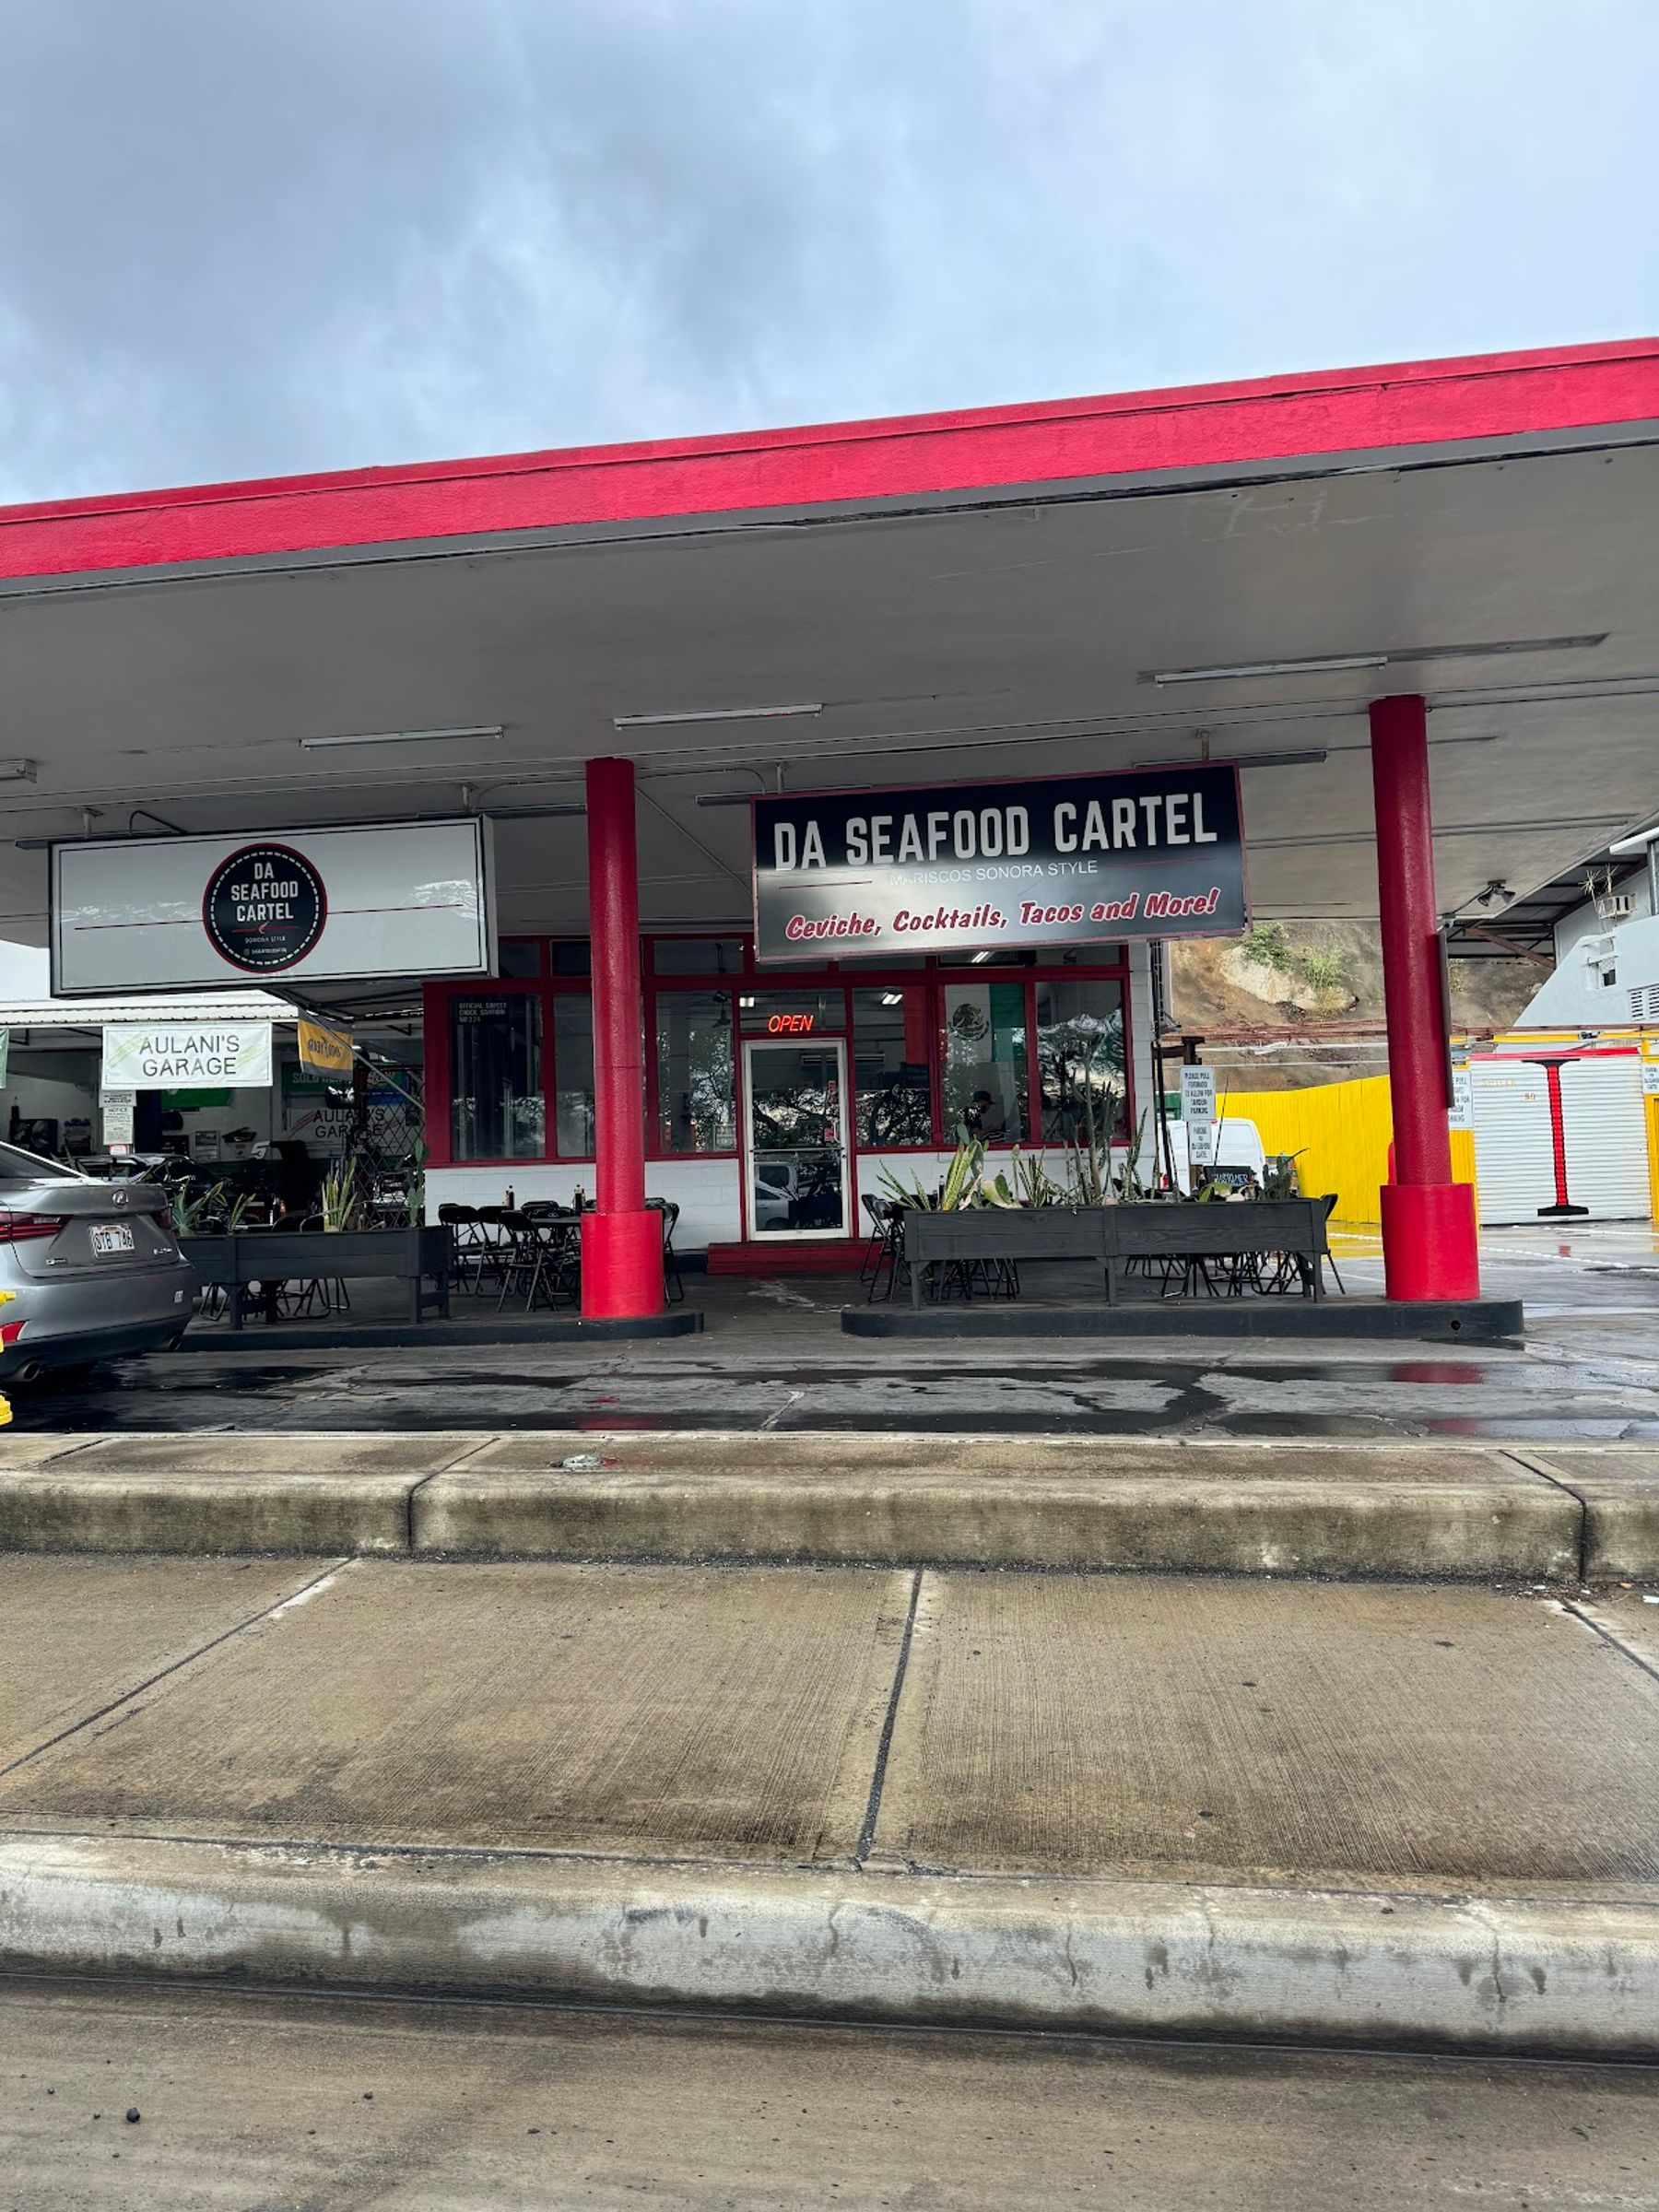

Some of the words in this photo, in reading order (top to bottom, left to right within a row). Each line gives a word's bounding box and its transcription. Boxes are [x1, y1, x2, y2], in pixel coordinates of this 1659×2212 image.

[774, 820, 826, 871] DA
[846, 806, 1030, 865] SEAFOOD
[1053, 793, 1218, 853] CARTEL
[253, 862, 275, 880] DA
[890, 869, 972, 886] MARISCOS
[975, 865, 1043, 882] SONORA
[1047, 860, 1099, 877] STYLE
[230, 881, 299, 901] SEAFOOD
[236, 902, 294, 923] CARTEL
[785, 911, 882, 941] Ceviche,
[892, 902, 1008, 933] Cocktails,
[1019, 900, 1084, 926] Tacos
[1089, 892, 1139, 922] and
[1145, 886, 1221, 918] More!
[767, 1014, 814, 1033] OPEN
[139, 1035, 240, 1054] AULANI'S
[142, 1057, 237, 1077] GARAGE
